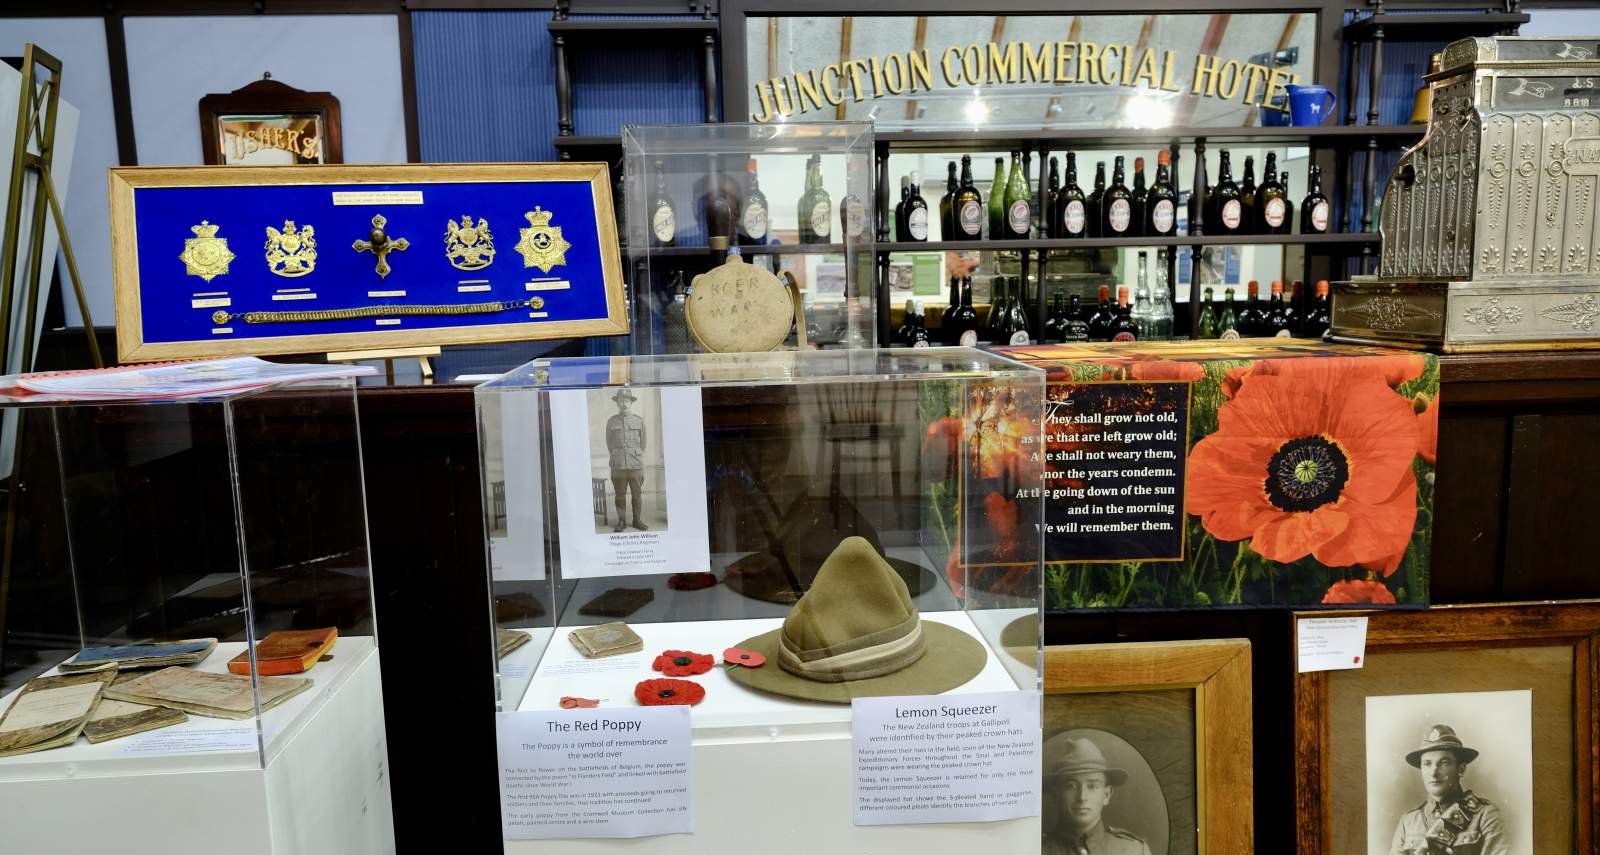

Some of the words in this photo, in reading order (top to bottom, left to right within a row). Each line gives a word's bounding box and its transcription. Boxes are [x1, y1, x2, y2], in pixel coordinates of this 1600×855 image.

[752, 48, 933, 123] JUNCTION
[940, 41, 1180, 92] COMMERCIAL
[230, 127, 316, 159] USHER'S
[1074, 413, 1101, 424] shall
[1104, 416, 1132, 425] grow
[1135, 413, 1154, 424] not
[1157, 412, 1178, 424] old,
[1056, 432, 1079, 442] that
[1103, 431, 1122, 442] left
[1125, 434, 1153, 443] grow
[1156, 431, 1178, 442] old;
[1030, 450, 1052, 462] Ae
[1056, 450, 1082, 460] shall
[1086, 450, 1104, 460] not
[1108, 452, 1141, 461] weary
[1144, 449, 1177, 461] them,
[1066, 468, 1084, 479] the
[1088, 471, 1118, 480] years
[1121, 467, 1176, 478] condemn.
[1015, 486, 1028, 497] At
[1053, 486, 1084, 498] going
[1087, 486, 1117, 496] down
[1120, 486, 1131, 496] of
[1134, 485, 1151, 496] the
[1067, 504, 1089, 515] and
[1092, 504, 1102, 515] in
[1106, 504, 1124, 515] the
[1127, 503, 1174, 516] morning
[1056, 522, 1076, 533] will
[1080, 521, 1138, 533] remember
[1142, 521, 1174, 532] them.
[896, 708, 937, 718] Lemon
[941, 705, 997, 718] Squeezer
[547, 721, 570, 732] The
[574, 720, 598, 731] Red
[602, 719, 641, 732] Poppy
[946, 720, 969, 730] troops
[981, 719, 1009, 728] Gallipoli
[926, 732, 935, 741] by
[956, 730, 982, 739] peaked
[537, 742, 560, 751] Poppy
[577, 740, 603, 750] symbol
[615, 738, 667, 746] remembrance
